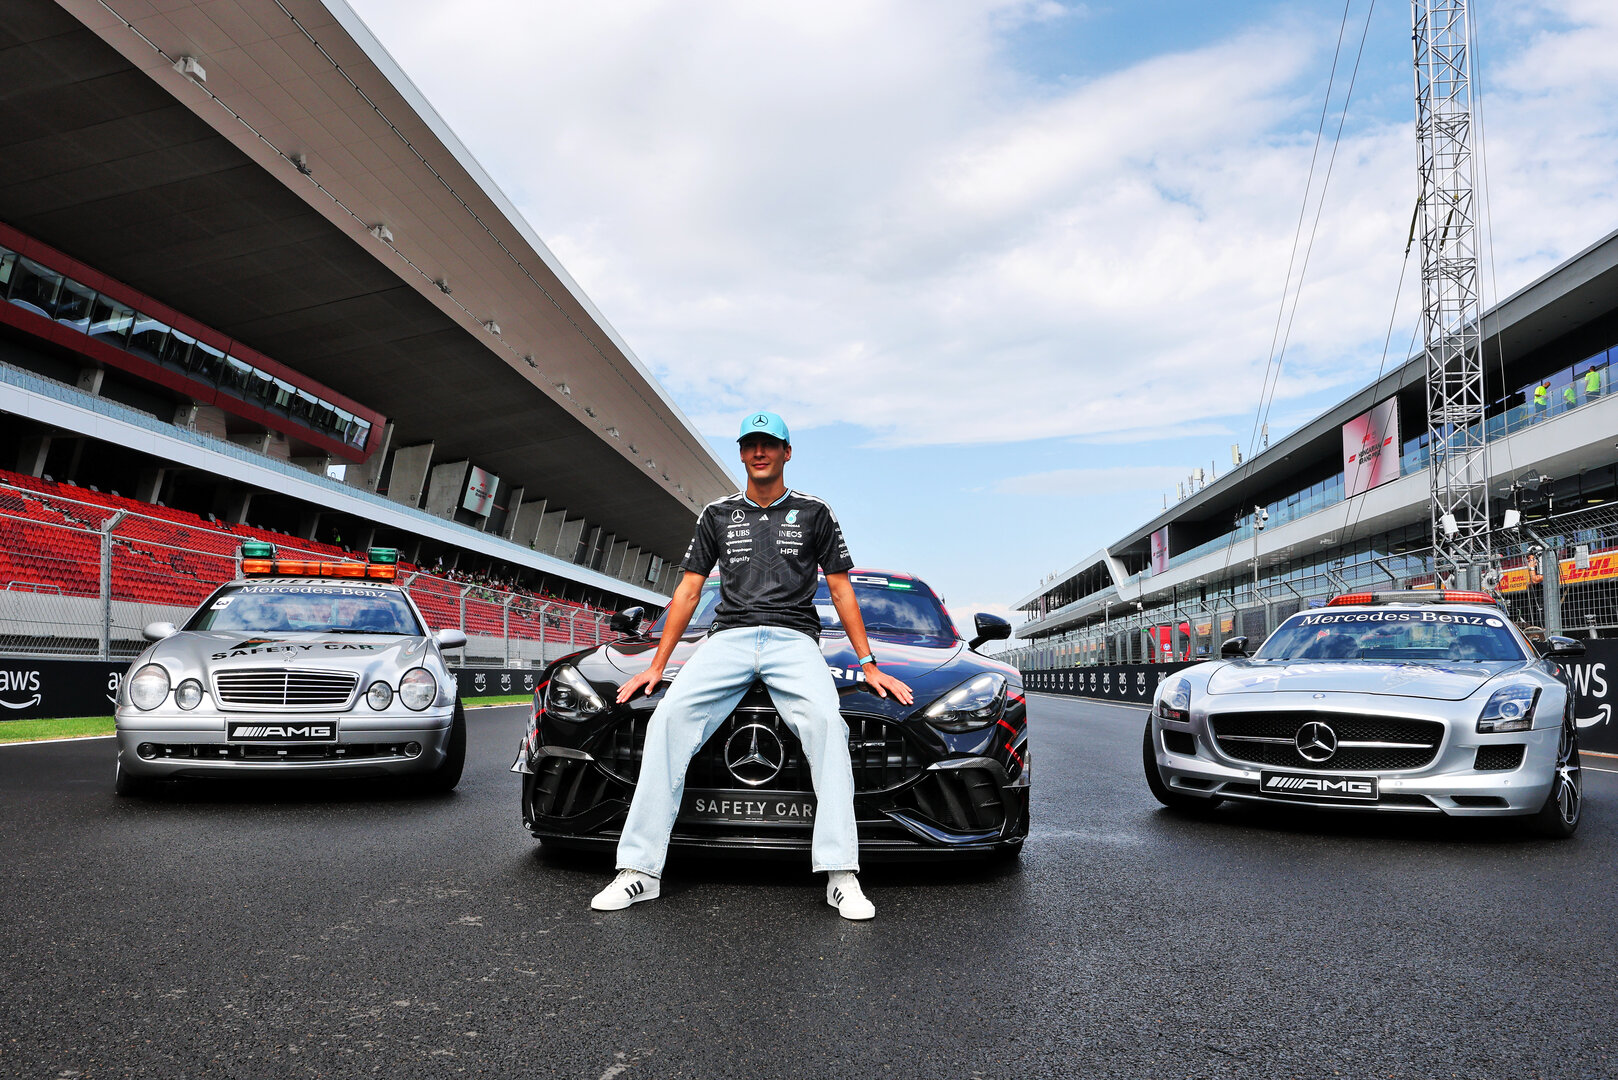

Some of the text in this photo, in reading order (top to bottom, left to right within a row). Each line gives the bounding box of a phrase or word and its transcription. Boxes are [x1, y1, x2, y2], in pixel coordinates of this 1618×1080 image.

[735, 529, 750, 537] UBS
[778, 530, 802, 538] INEOS
[780, 548, 799, 556] HPE
[238, 586, 388, 598] Mercedes-Benz
[1299, 611, 1484, 627] Mercedes-Benz
[211, 645, 314, 660] SAFETY
[1565, 663, 1608, 698] ws
[695, 798, 813, 817] SAFETY CAR
